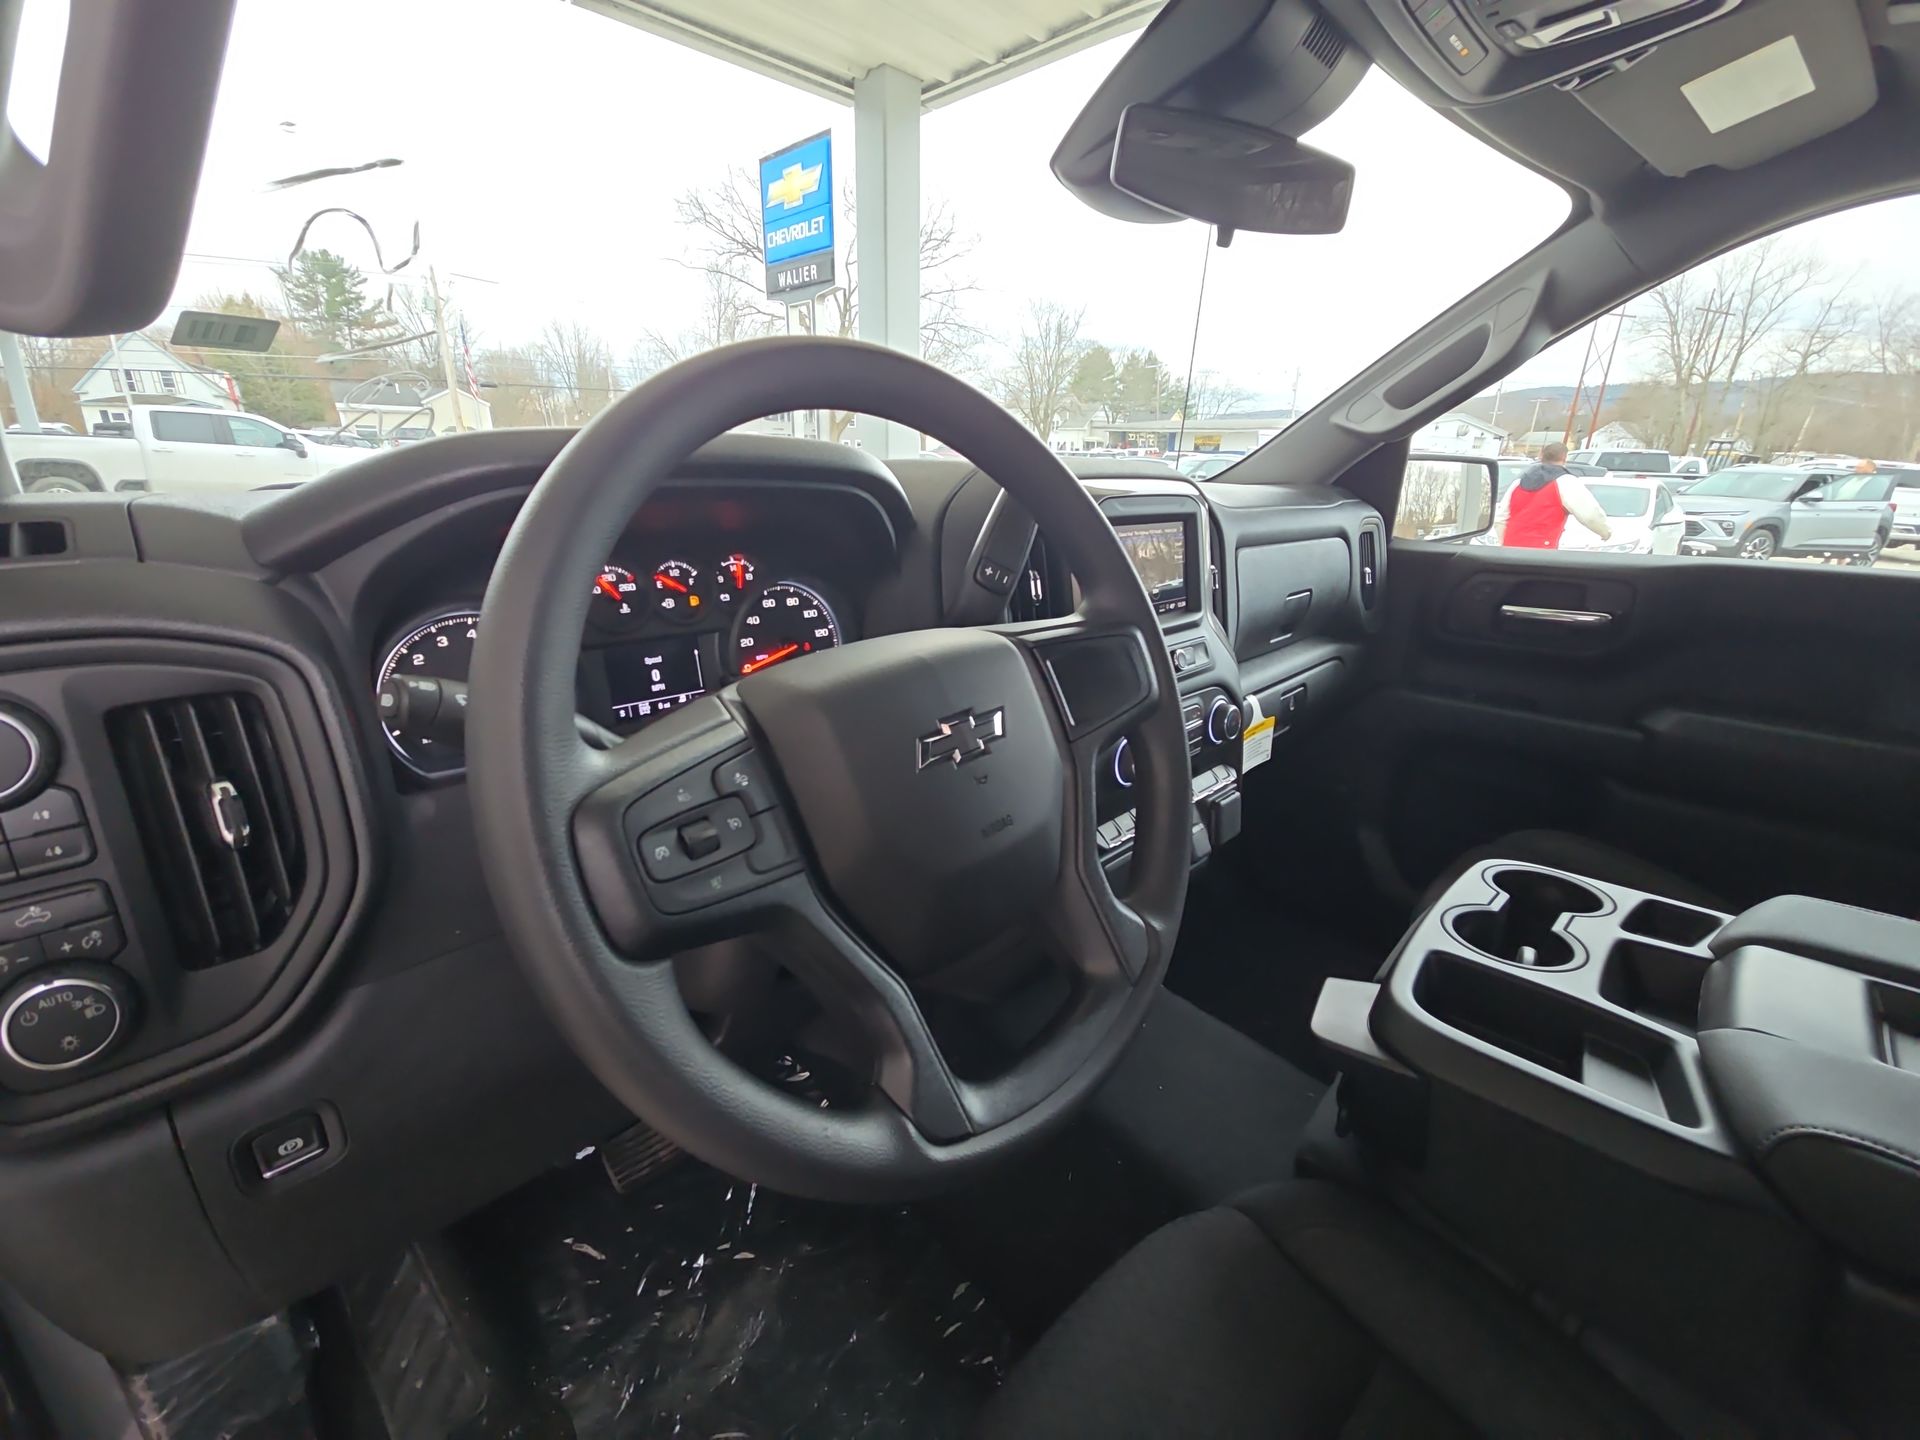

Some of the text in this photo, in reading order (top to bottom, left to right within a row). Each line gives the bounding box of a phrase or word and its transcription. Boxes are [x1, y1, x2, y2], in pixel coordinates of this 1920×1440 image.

[767, 216, 825, 248] CHEVROLET
[778, 264, 817, 287] WALIER
[656, 580, 664, 589] E
[688, 577, 695, 586] F
[762, 599, 776, 608] 60
[786, 597, 799, 607] 80
[803, 609, 818, 619] 100
[746, 616, 760, 625] 40
[466, 629, 477, 639] 4
[814, 628, 829, 638] 120
[436, 636, 449, 647] 3
[740, 637, 754, 648] 20
[412, 654, 425, 666] 2
[651, 669, 660, 681] 0
[38, 991, 73, 1010] AUTO
